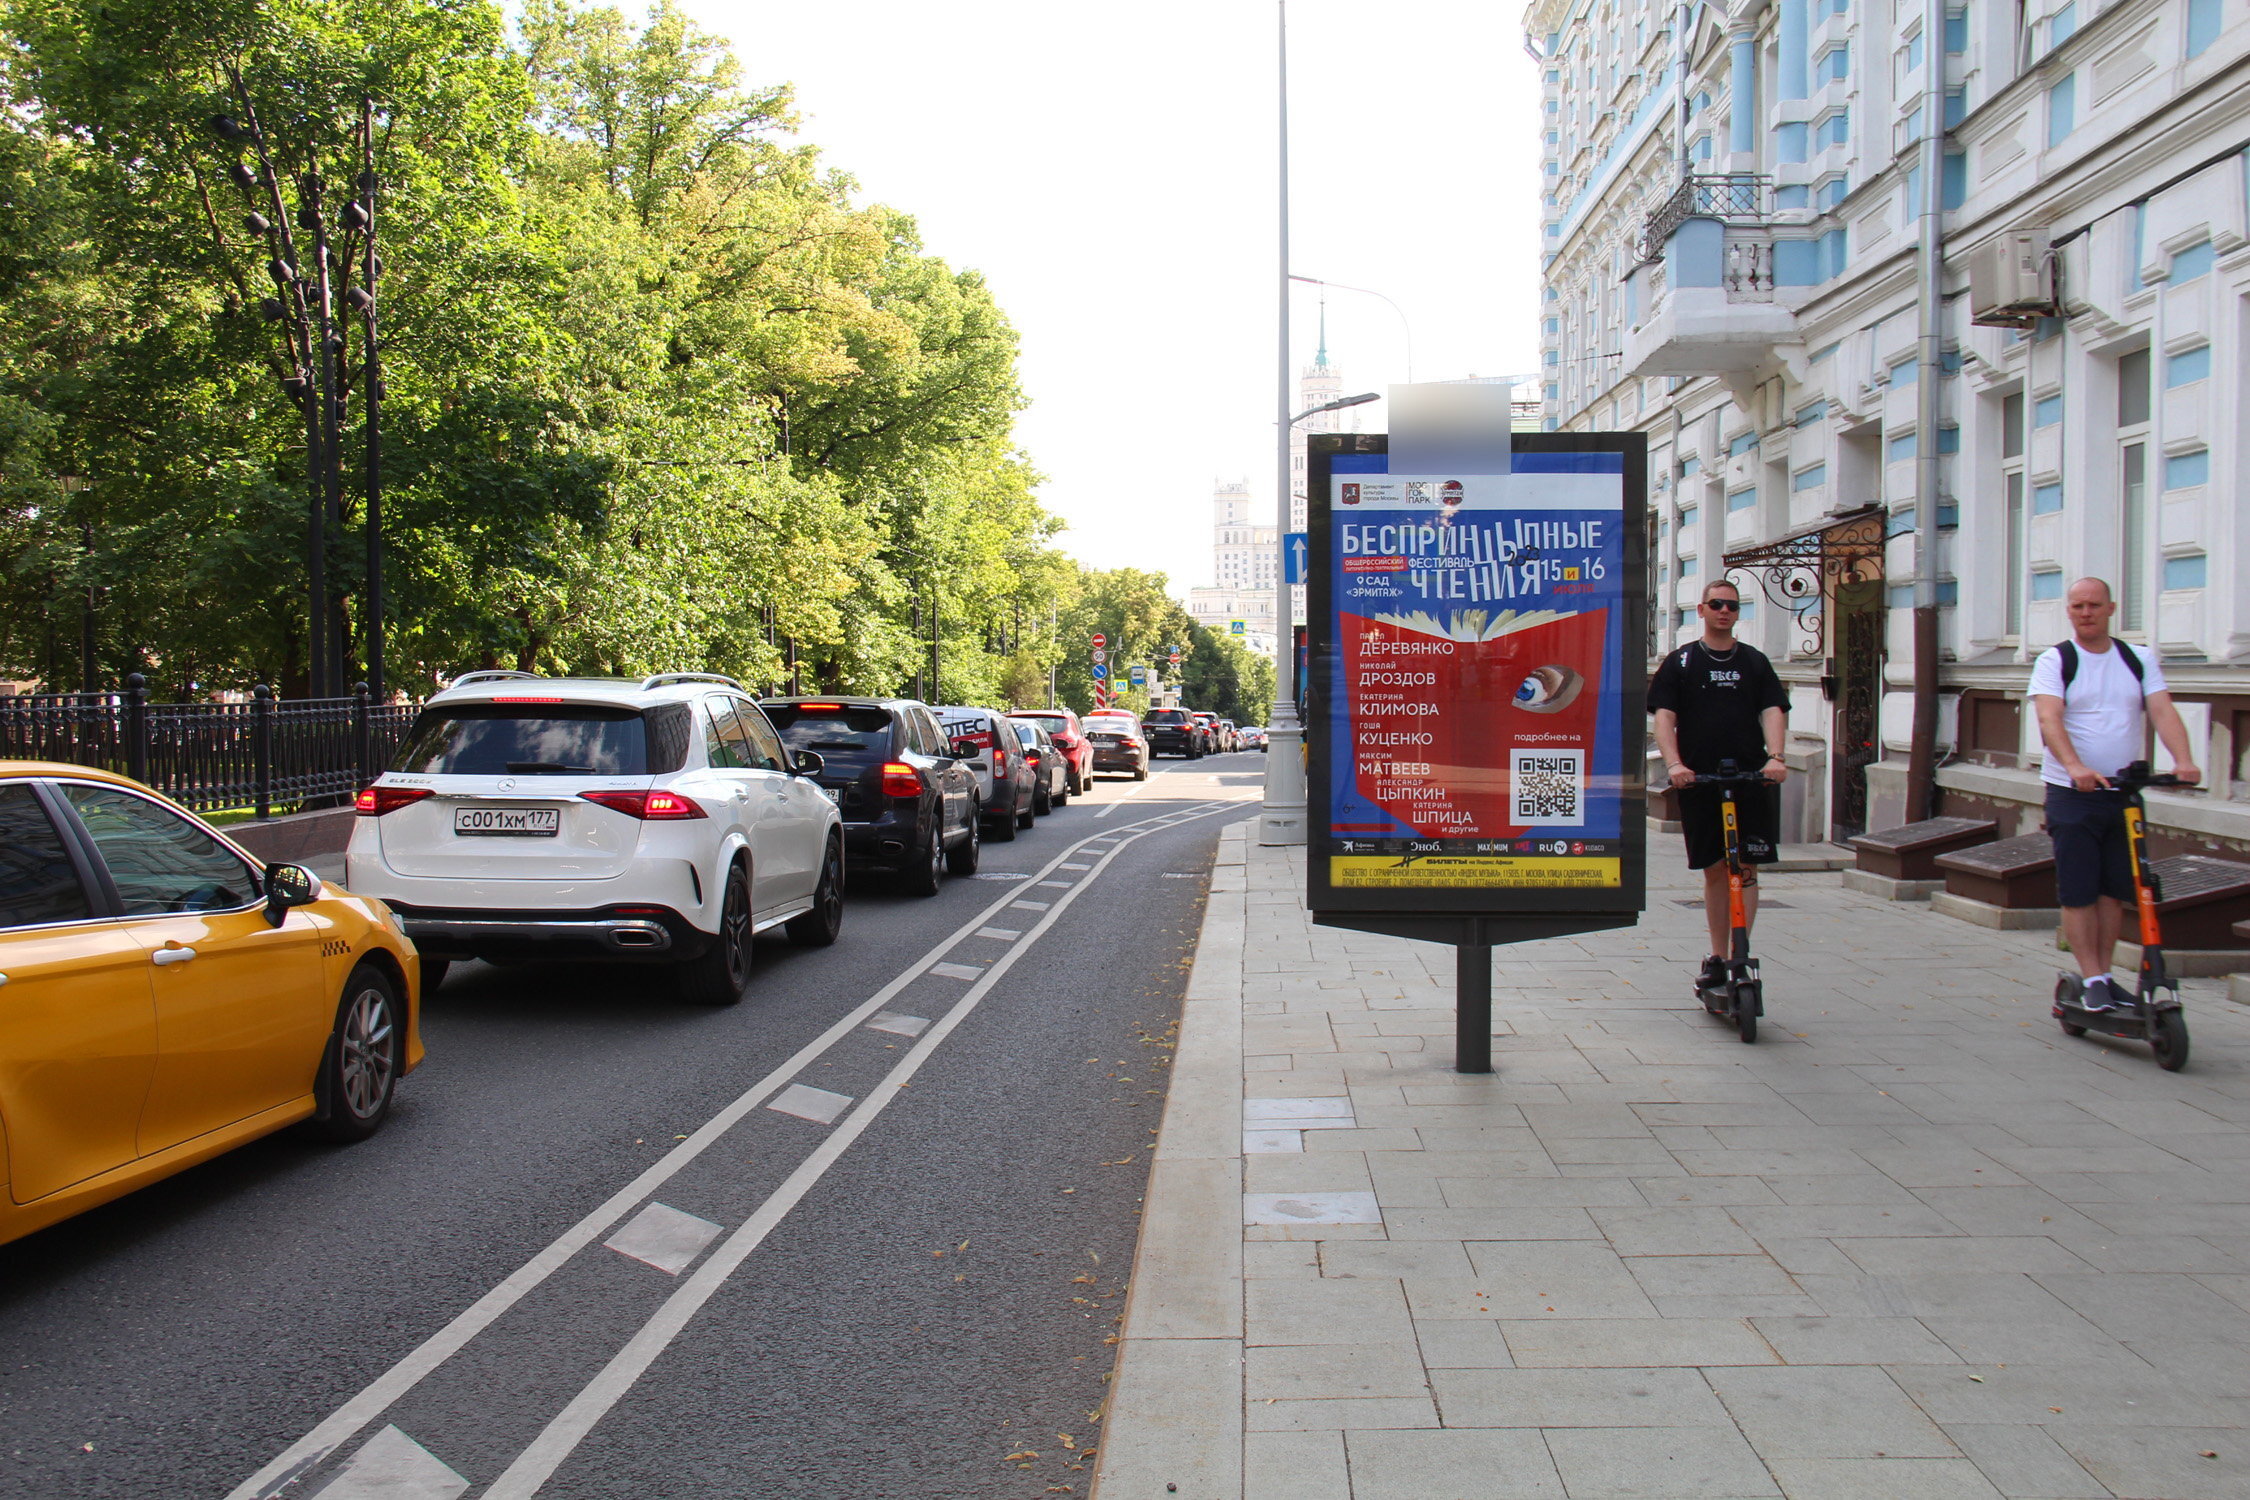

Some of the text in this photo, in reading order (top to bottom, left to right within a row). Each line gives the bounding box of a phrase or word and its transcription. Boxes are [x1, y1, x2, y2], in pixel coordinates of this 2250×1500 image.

[1343, 519, 1602, 564] БЕСПРИНЦЫПНЫЕ
[1408, 557, 1475, 569] ФЕСТИВАЛЬ
[1541, 559, 1561, 581] 15
[1582, 556, 1605, 580] 16
[1366, 576, 1389, 586] САД
[1411, 560, 1540, 602] ЧТЕНИЯ
[1346, 588, 1403, 597] «ЭРМИТАЖ»
[1553, 583, 1594, 594] ИЮЛЯ
[1360, 642, 1454, 656] ДЕРЕВЯНКО
[1360, 661, 1396, 669] НИКОЛАЙ
[1359, 672, 1436, 687] ДРОЗДОВ
[1360, 703, 1439, 715] КЛИМОВА
[1360, 732, 1433, 747] КУЦЕНКО
[1514, 732, 1567, 742] подробнее
[1360, 763, 1430, 775] МАТВЕЕВ
[1377, 788, 1445, 801] ЦЫПКИН
[529, 812, 552, 824] 177
[1413, 811, 1473, 825] ШПИЦА
[1449, 826, 1479, 834] другие
